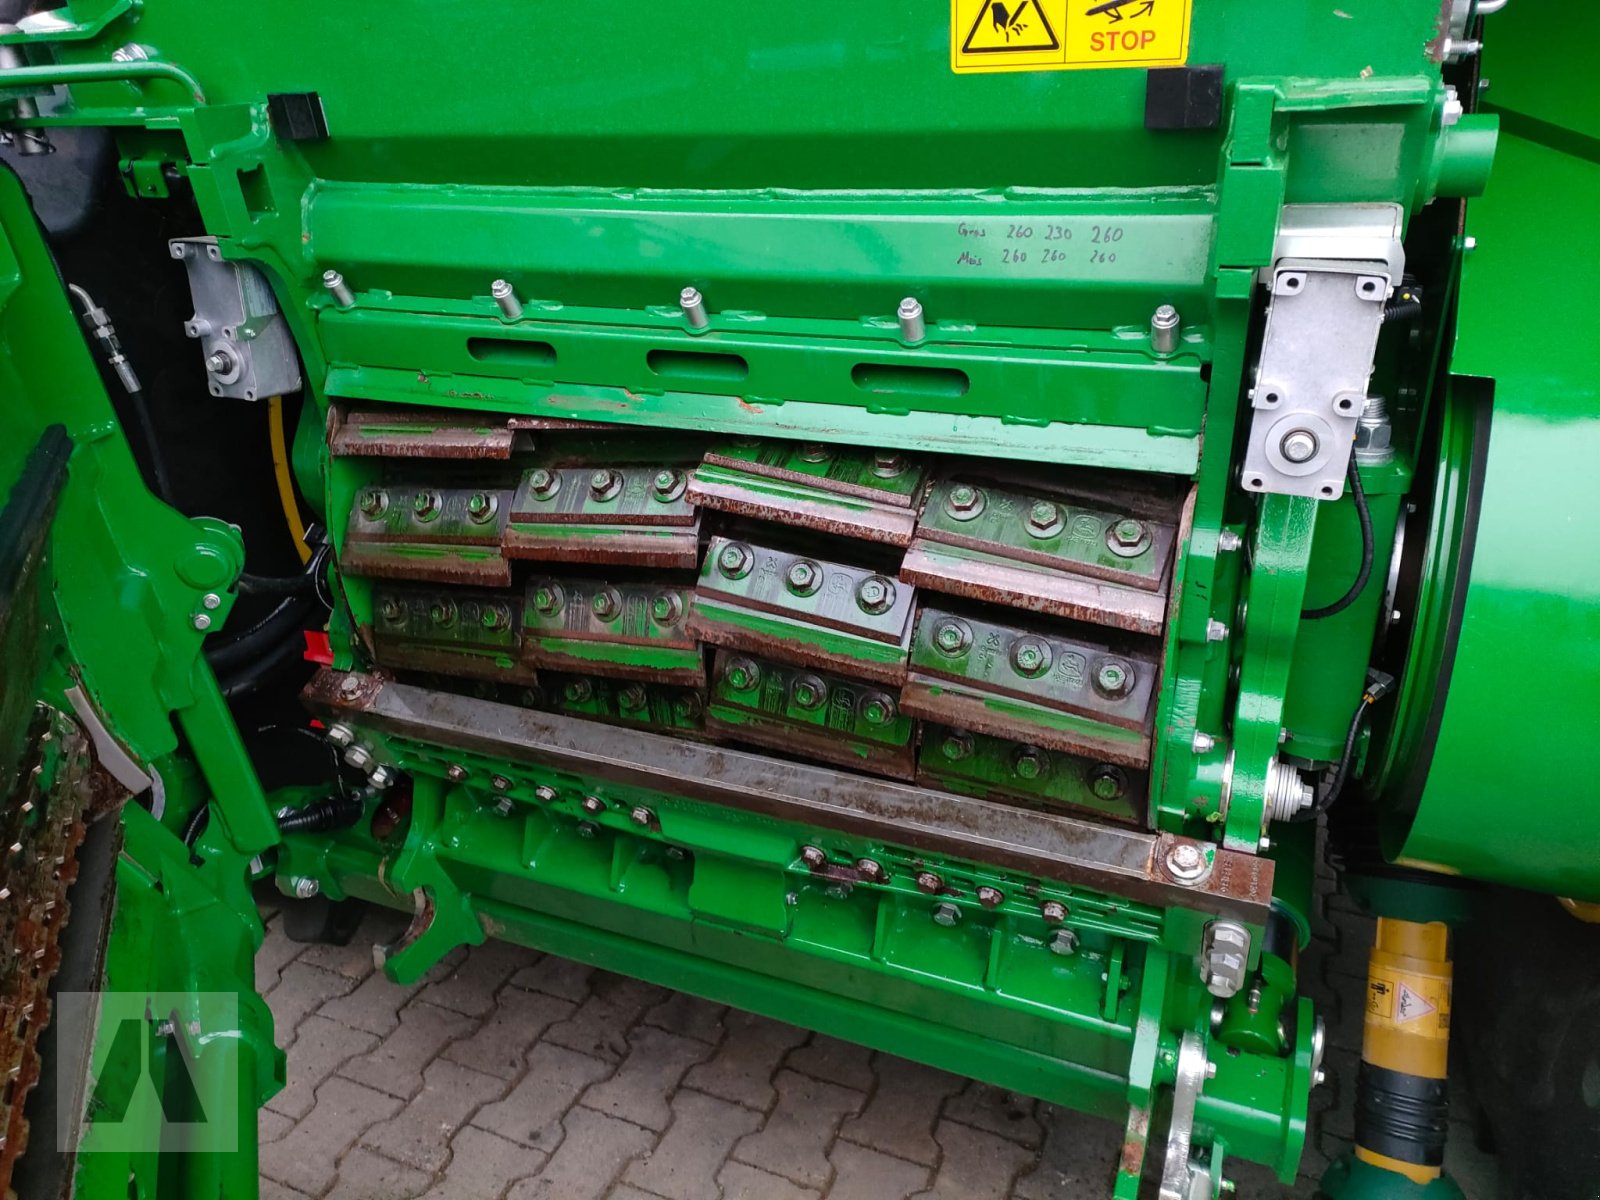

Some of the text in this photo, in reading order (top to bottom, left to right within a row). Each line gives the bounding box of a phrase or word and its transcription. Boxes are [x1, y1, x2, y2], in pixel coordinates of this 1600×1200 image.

[1090, 30, 1156, 52] STOP
[1007, 224, 1032, 238] 260
[1045, 224, 1072, 240] 230
[1092, 225, 1123, 243] 260
[1002, 247, 1027, 263] 260
[1041, 248, 1066, 263] 260
[1090, 249, 1116, 263] 260
